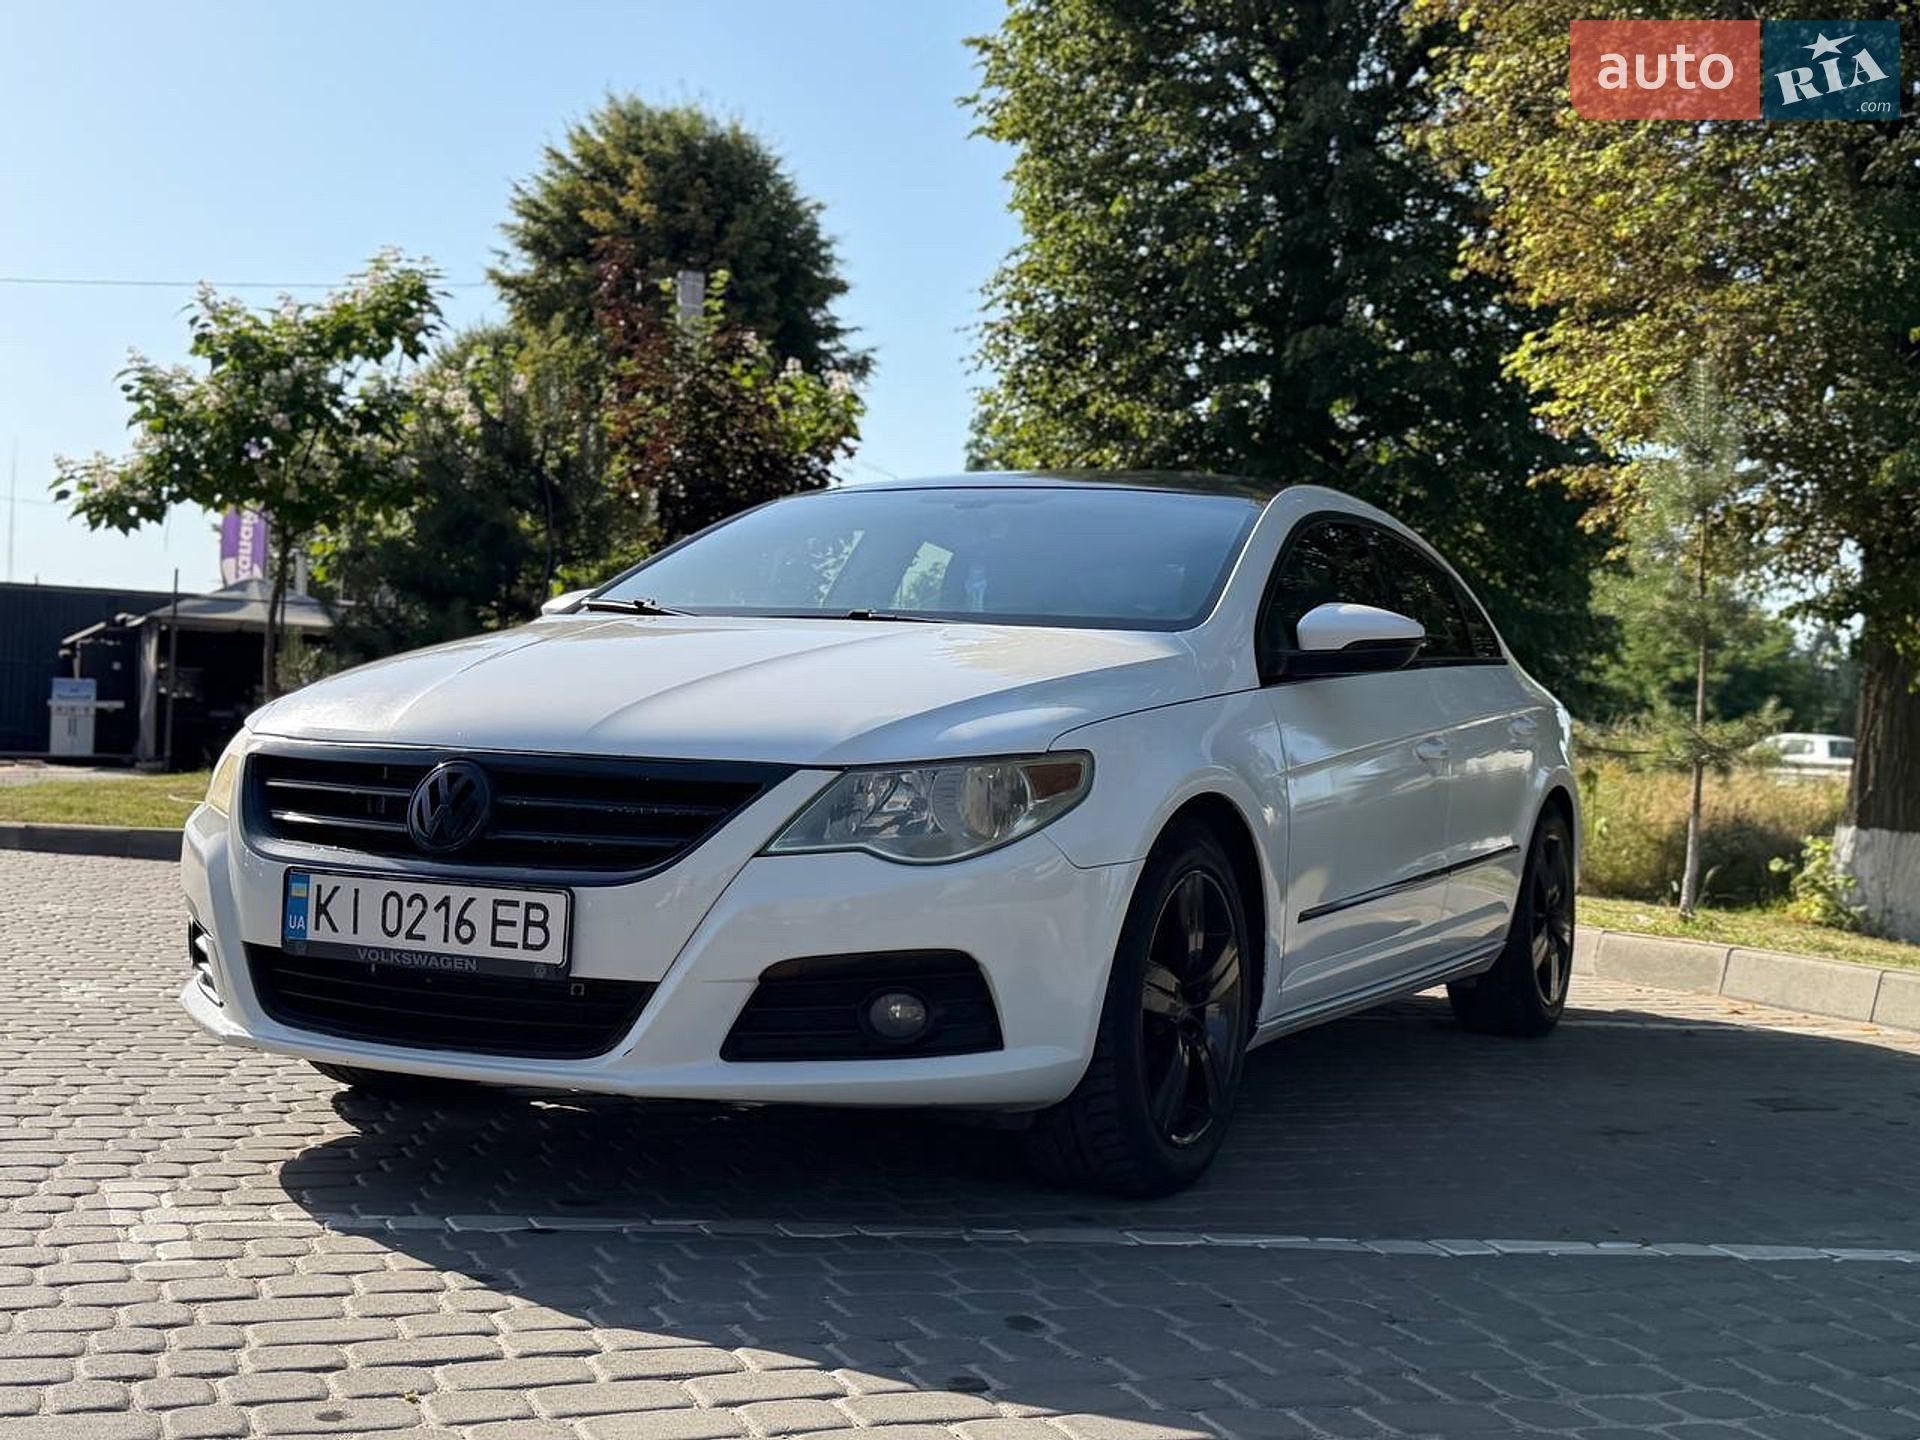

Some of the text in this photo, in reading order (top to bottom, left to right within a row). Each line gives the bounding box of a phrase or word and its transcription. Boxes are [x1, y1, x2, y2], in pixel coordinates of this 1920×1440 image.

[288, 914, 306, 931] UA
[381, 890, 478, 945] 0216
[490, 899, 551, 951] EB
[357, 947, 479, 972] VOLKSWAGEN
